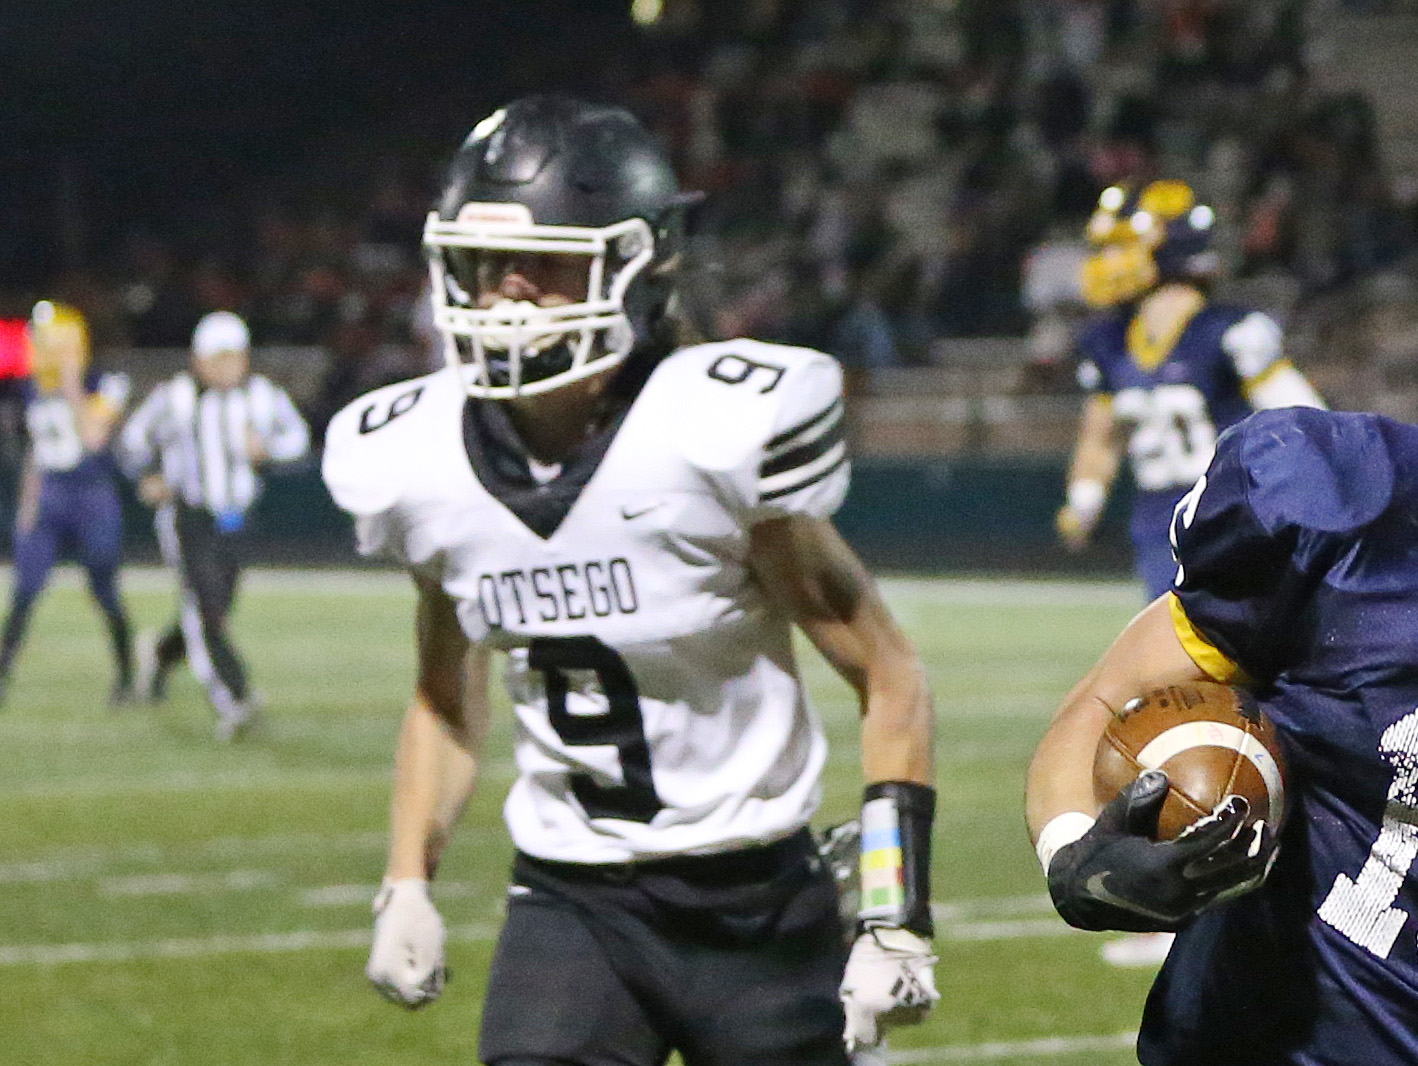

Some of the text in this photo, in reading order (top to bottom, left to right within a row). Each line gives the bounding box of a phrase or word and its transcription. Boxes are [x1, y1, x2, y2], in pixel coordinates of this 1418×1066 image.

[708, 354, 786, 394] 9
[1114, 383, 1217, 491] 20
[478, 557, 640, 628] OTSEGO
[528, 635, 665, 824] 9
